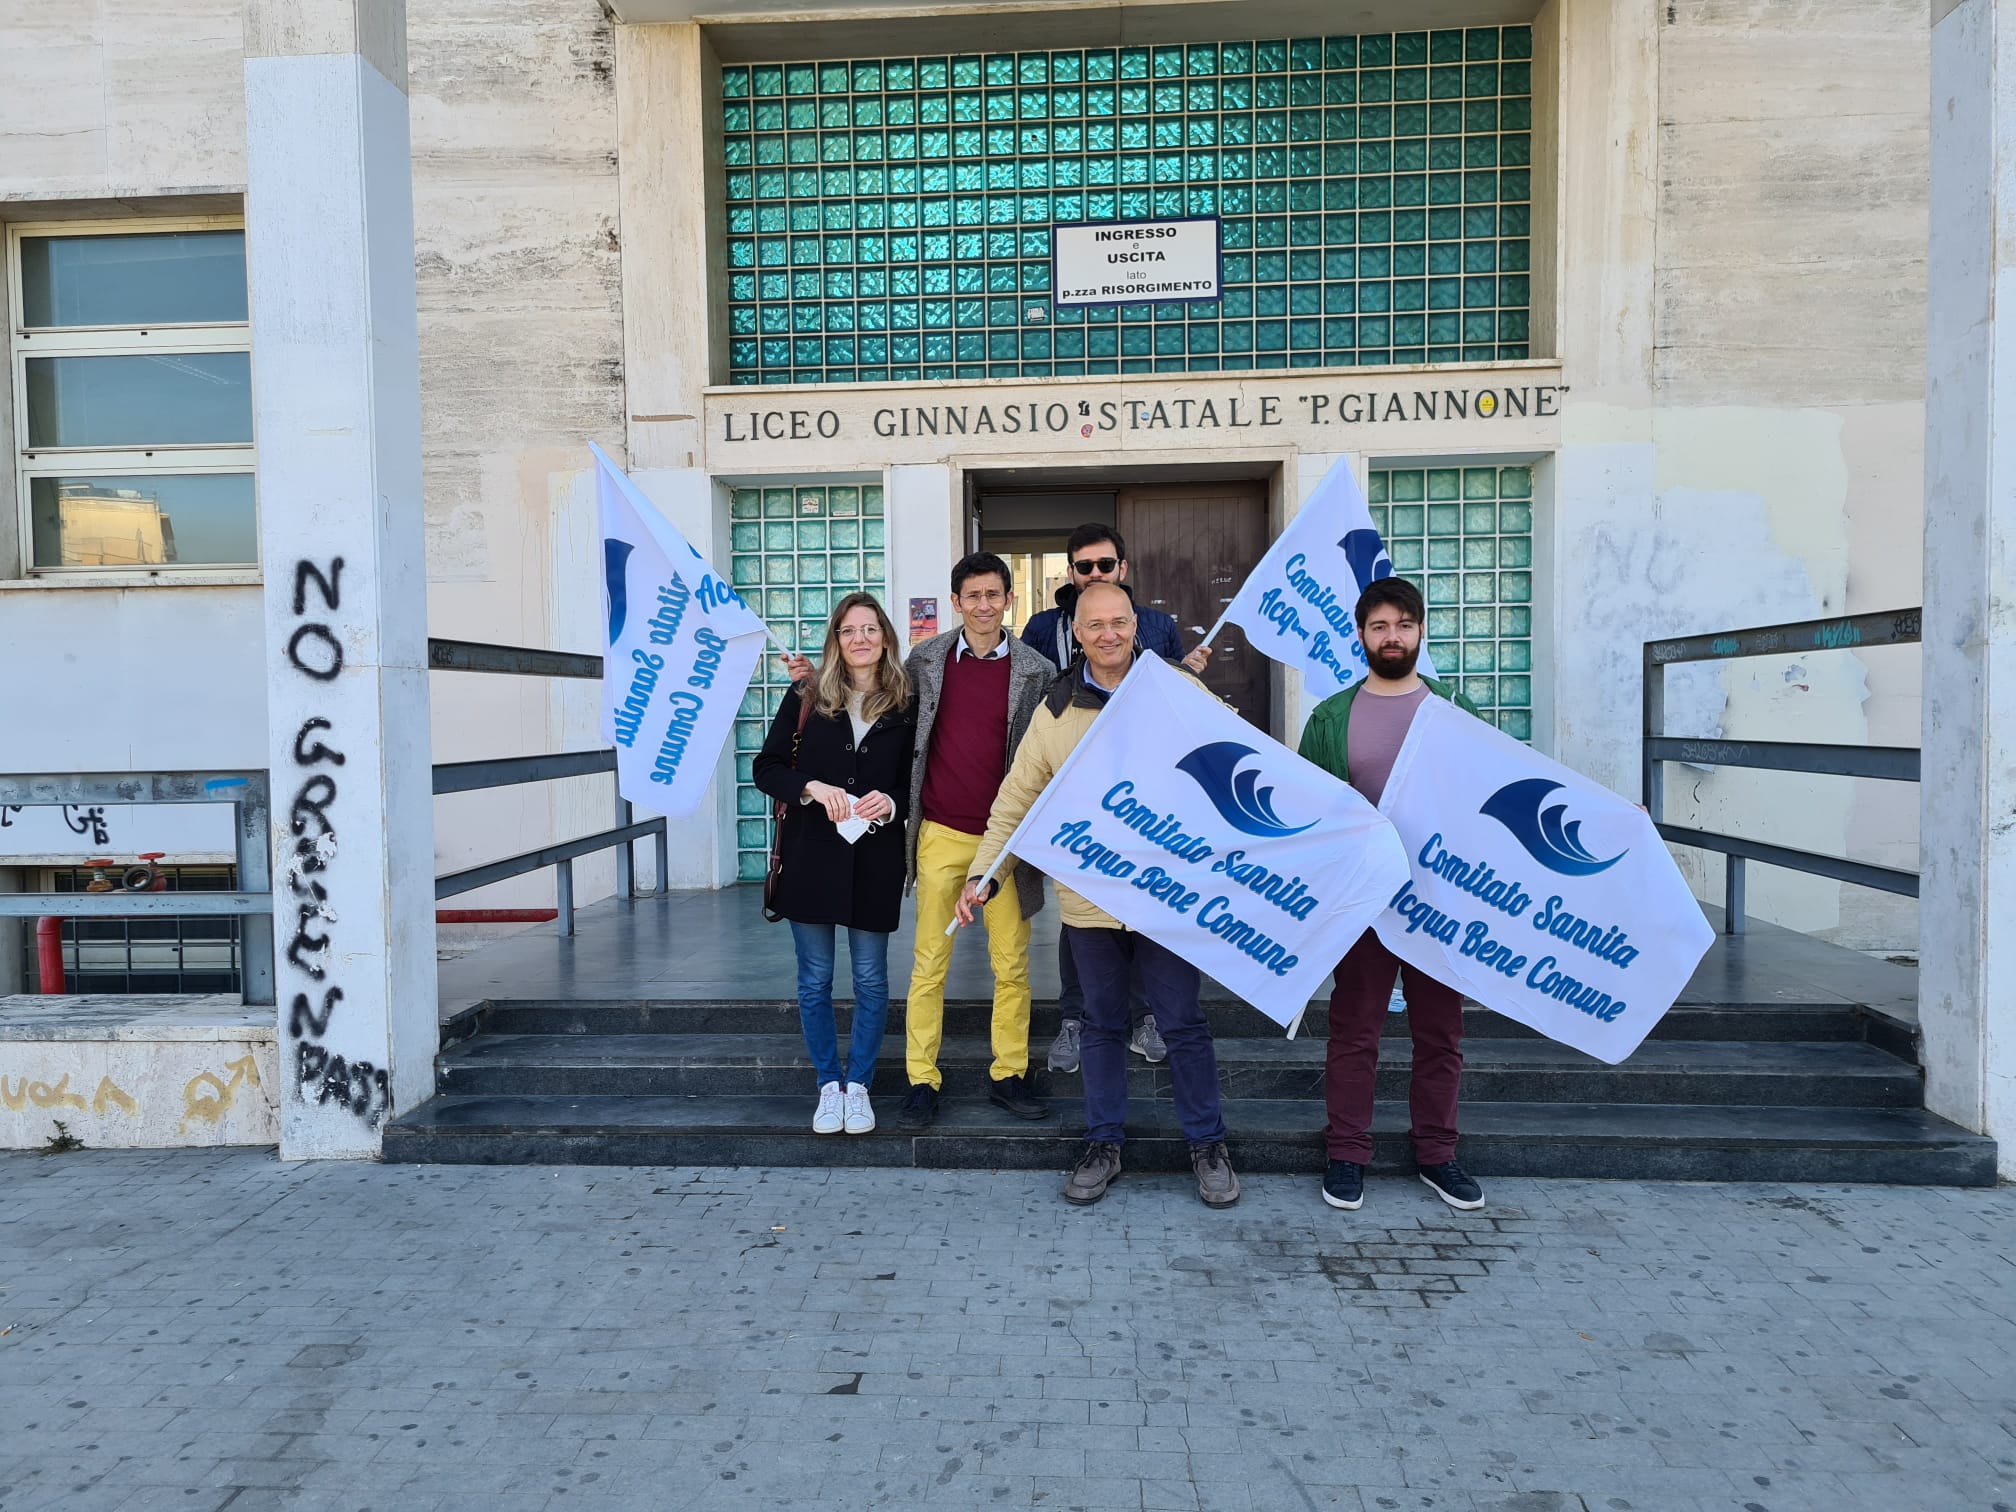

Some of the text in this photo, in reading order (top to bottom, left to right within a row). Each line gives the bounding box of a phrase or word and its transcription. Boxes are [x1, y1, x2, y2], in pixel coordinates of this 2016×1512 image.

[1095, 227, 1177, 242] INGRESSO
[1107, 251, 1166, 264] USCITA
[1126, 270, 1147, 280] lato
[1132, 241, 1140, 250] e
[1062, 280, 1212, 299] p.zza RISORGIMENTO
[723, 409, 840, 442] LICEO
[873, 402, 1069, 438] GINNASIO
[1098, 396, 1283, 431] STATALE
[288, 556, 344, 681] NO
[1258, 587, 1310, 642] Acqu
[1308, 630, 1353, 685] Bene
[1285, 553, 1354, 638] Comitato
[1101, 780, 1319, 921] Comitato Sannita
[1050, 820, 1299, 977] Acqua Bene Comune
[1418, 833, 1640, 969] Comitato Sannita
[1459, 920, 1528, 978] Bene
[1525, 955, 1627, 1023] Comune
